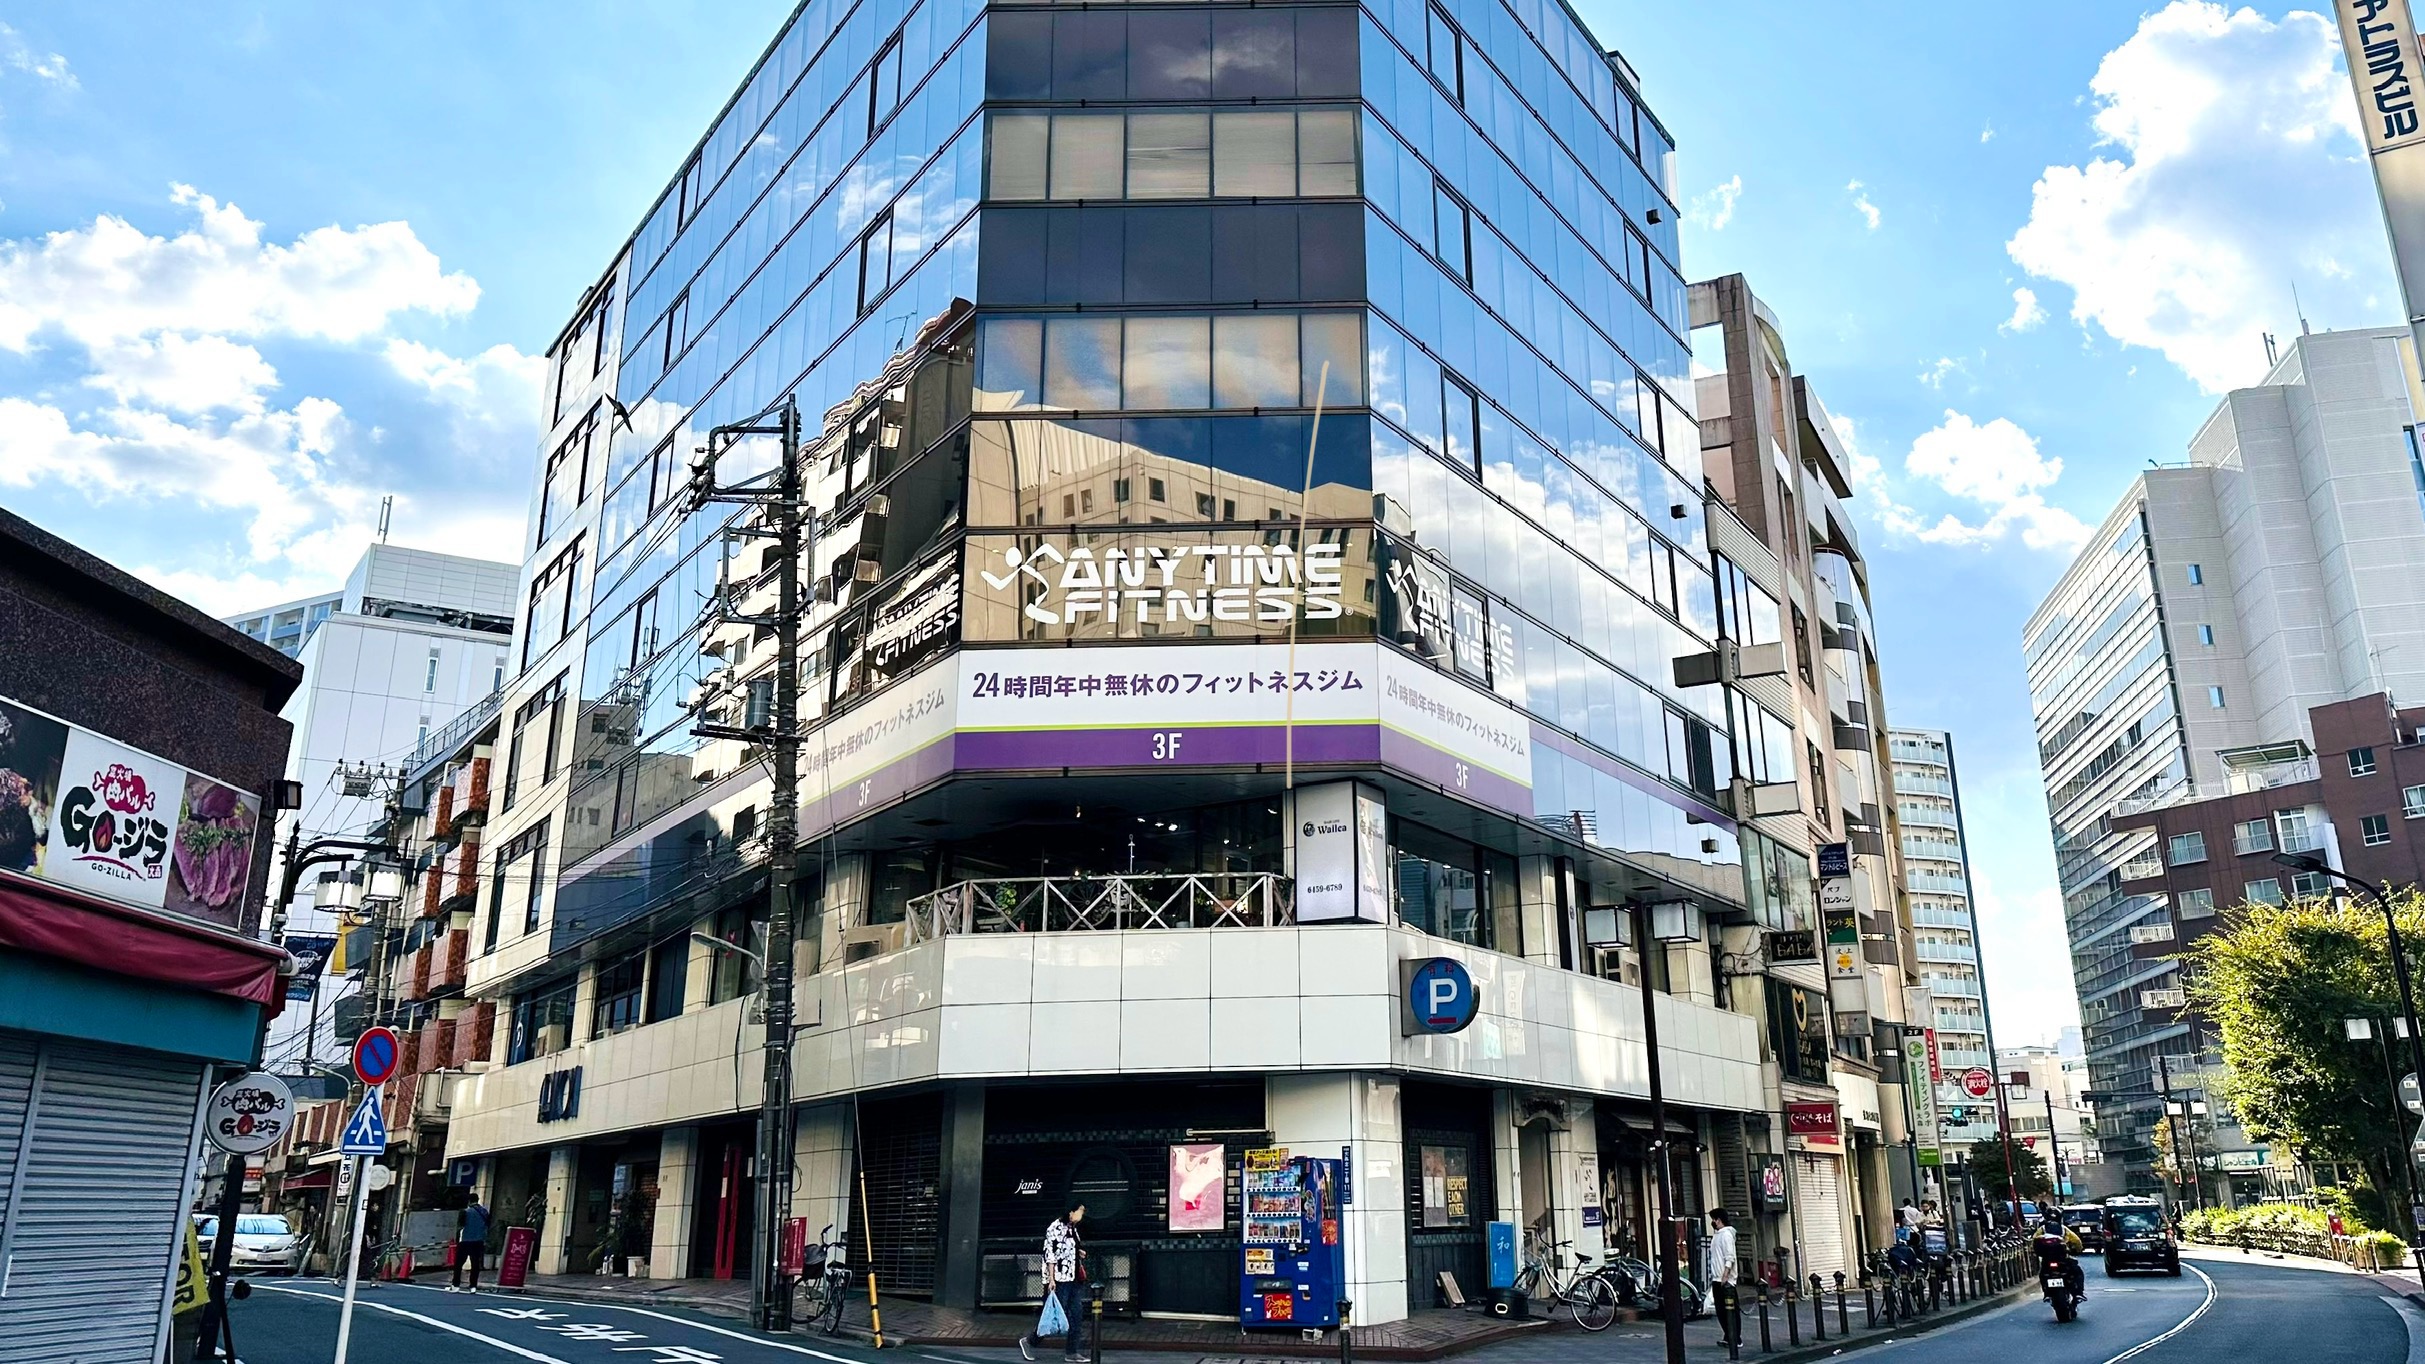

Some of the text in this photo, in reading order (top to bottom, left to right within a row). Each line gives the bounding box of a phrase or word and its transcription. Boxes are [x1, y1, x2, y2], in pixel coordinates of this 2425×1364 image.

[1058, 543, 1342, 587] ANYTIME
[1063, 588, 1342, 623] FITNESS
[973, 671, 1364, 699] 24時間年中無休のフィットネスジム
[1152, 734, 1182, 759] 3F
[1455, 762, 1469, 789] 3F
[858, 779, 872, 807] 3F
[91, 862, 131, 880] GO-ZILLA
[1429, 978, 1458, 1015] P
[1967, 1078, 1988, 1089] 消火栓
[456, 1161, 476, 1185] P
[1014, 1179, 1043, 1194] janis
